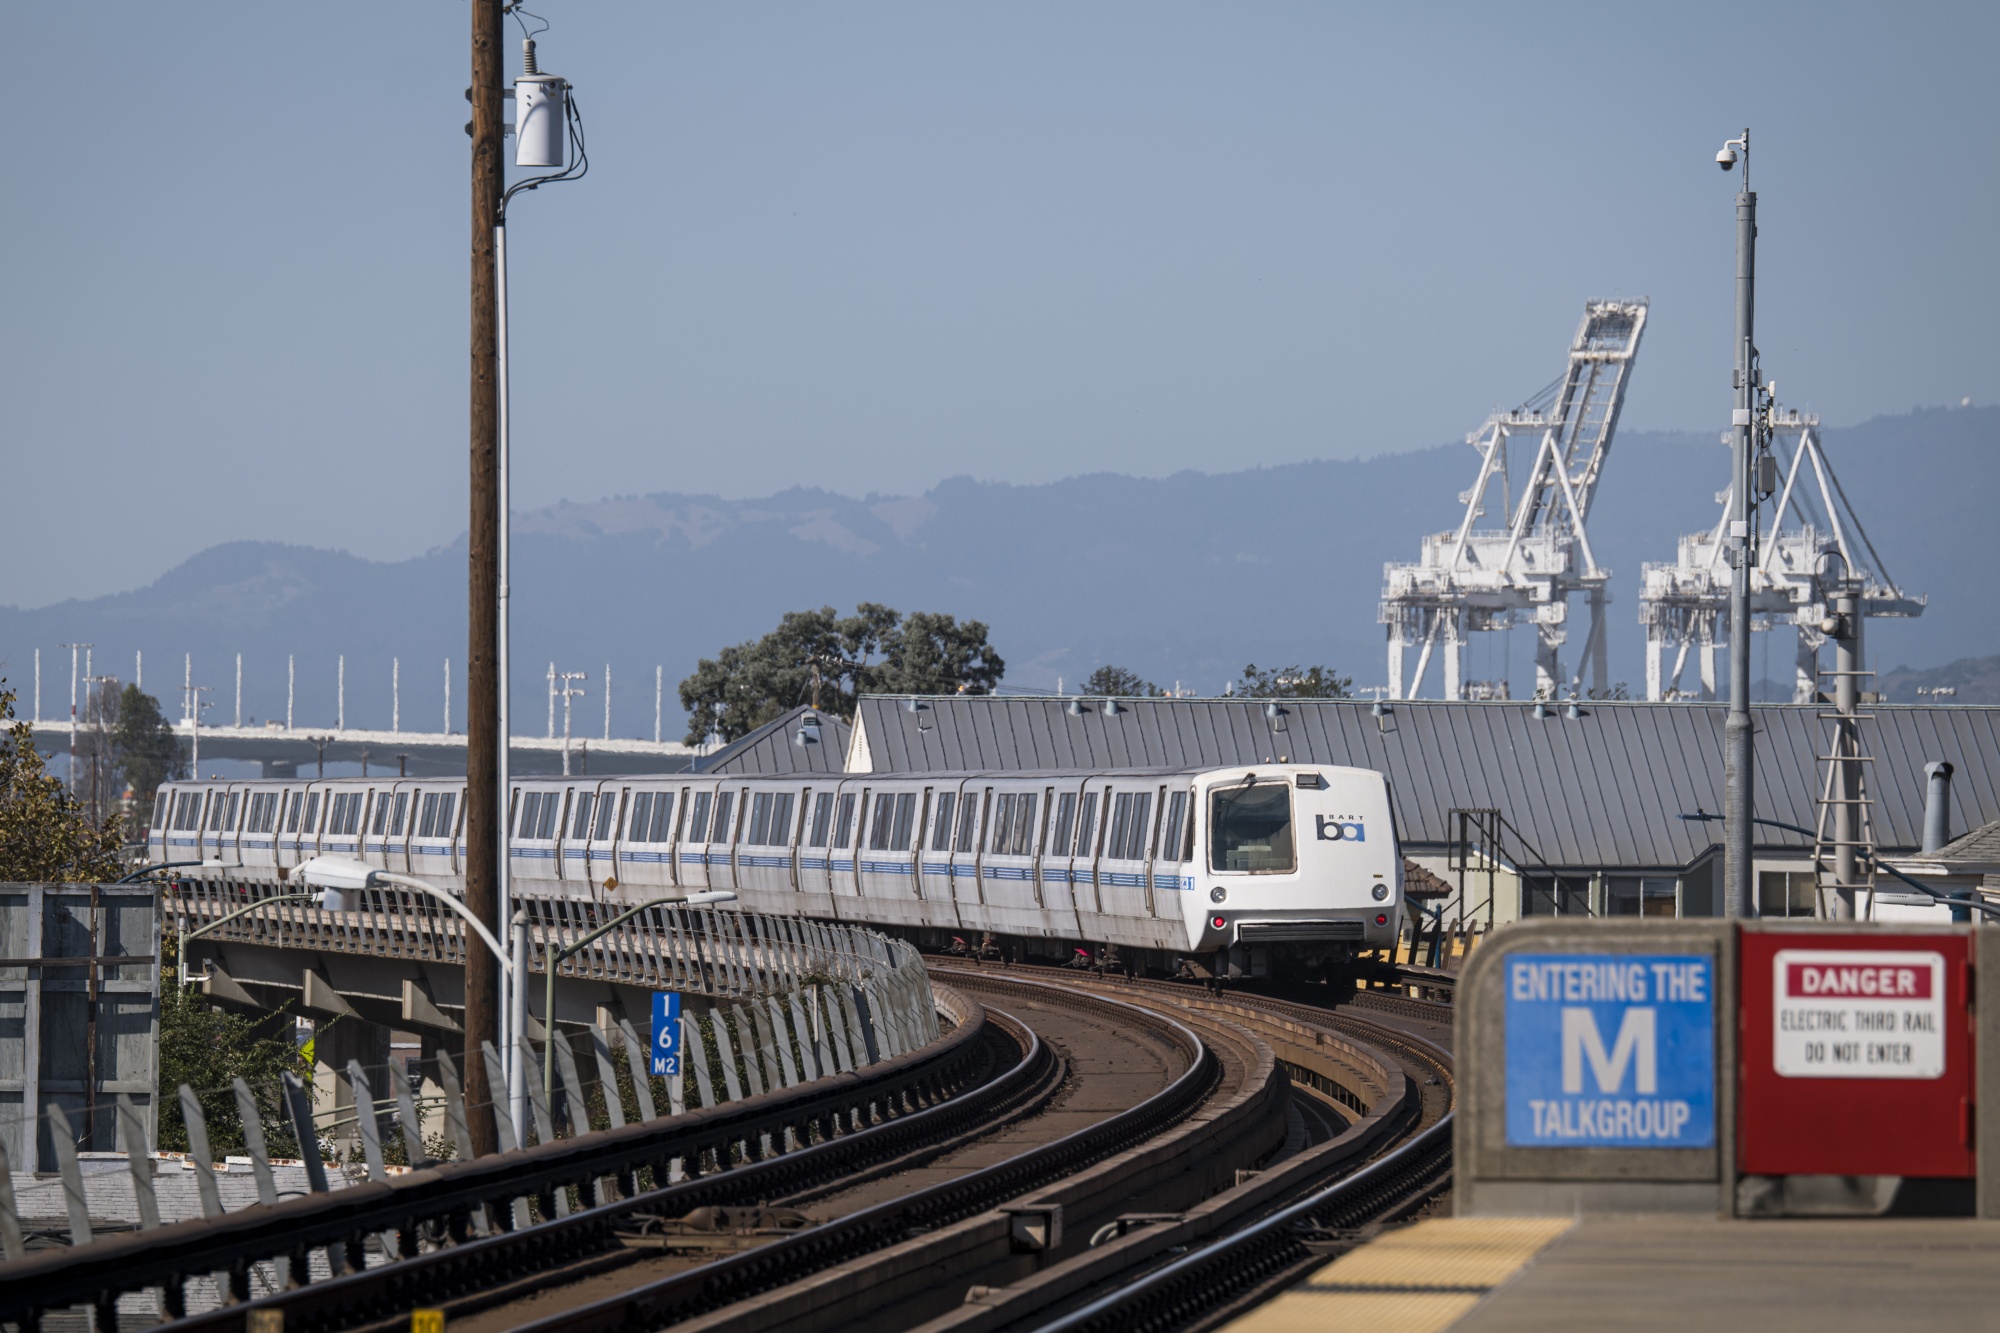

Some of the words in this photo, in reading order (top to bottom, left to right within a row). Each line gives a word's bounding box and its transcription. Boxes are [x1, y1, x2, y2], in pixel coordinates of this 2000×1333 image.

[1512, 963, 1646, 1001] ENTERING
[1652, 963, 1706, 1001] THE
[1802, 967, 1916, 995] DANGER
[664, 994, 669, 1017] 1
[1781, 1009, 1847, 1032] ELECTRIC
[1855, 1010, 1895, 1032] THIRD
[1903, 1011, 1936, 1034] RAIL
[659, 1026, 672, 1048] 6
[1562, 1007, 1657, 1094] M
[1805, 1042, 1825, 1063] DO
[1832, 1042, 1859, 1063] NOT
[1867, 1043, 1911, 1065] ENTER
[655, 1058, 675, 1073] M2
[1529, 1101, 1691, 1139] TALKGROUP
